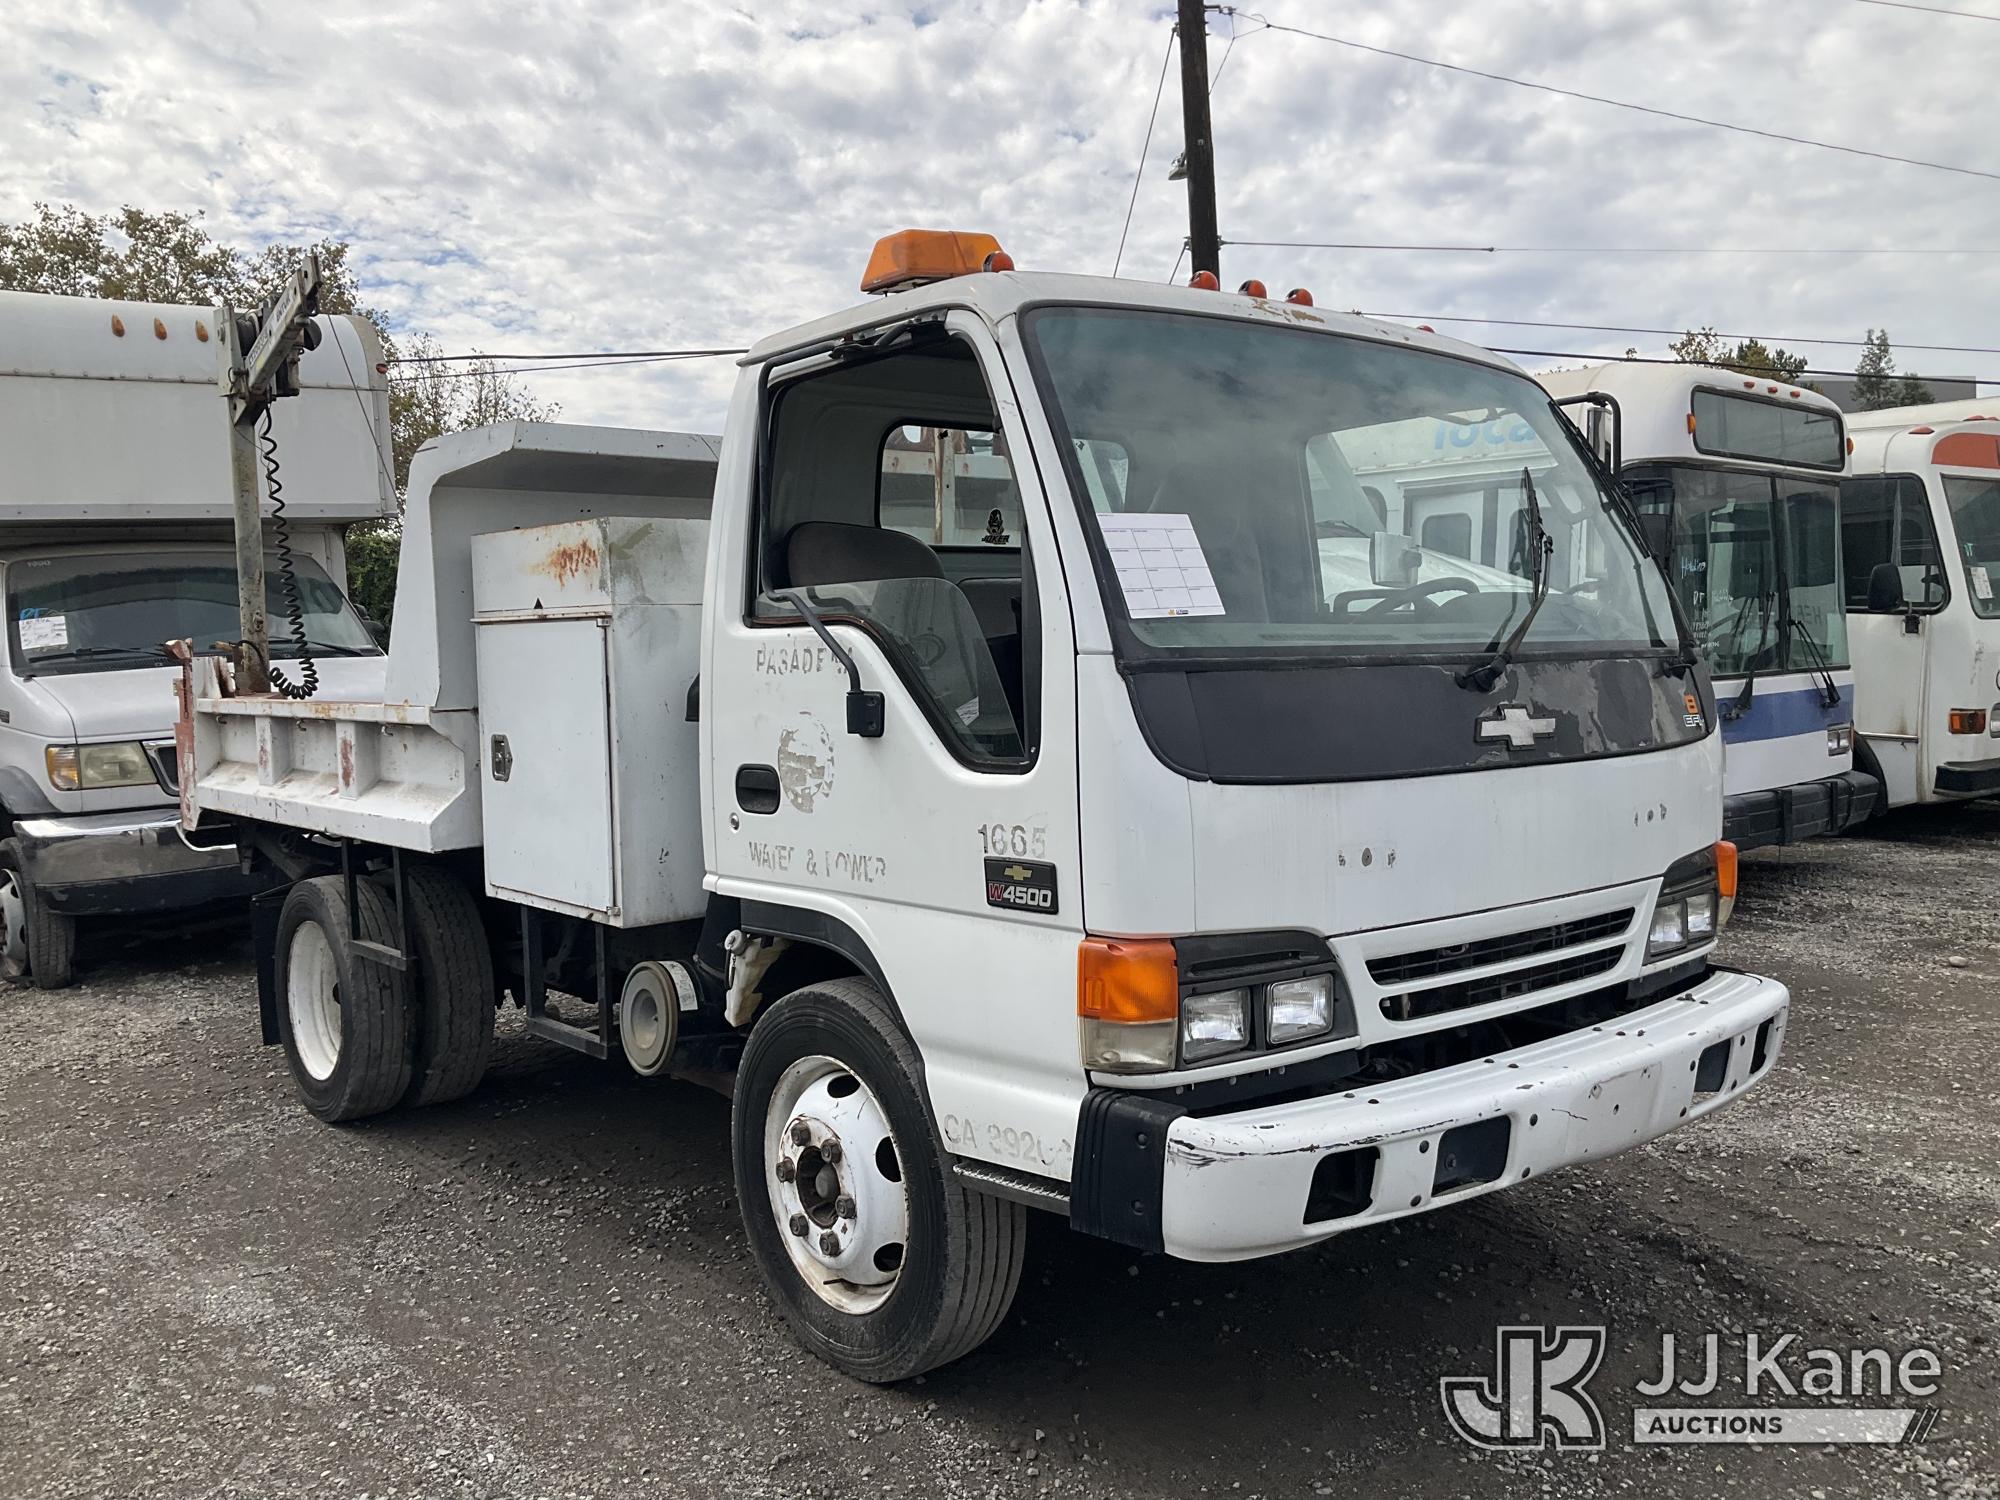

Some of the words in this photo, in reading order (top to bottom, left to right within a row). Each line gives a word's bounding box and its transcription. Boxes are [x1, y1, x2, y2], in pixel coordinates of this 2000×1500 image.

[978, 823, 1046, 858] 1665
[806, 848, 818, 876] &
[988, 883, 1052, 907] W4500
[944, 1114, 977, 1148] CA
